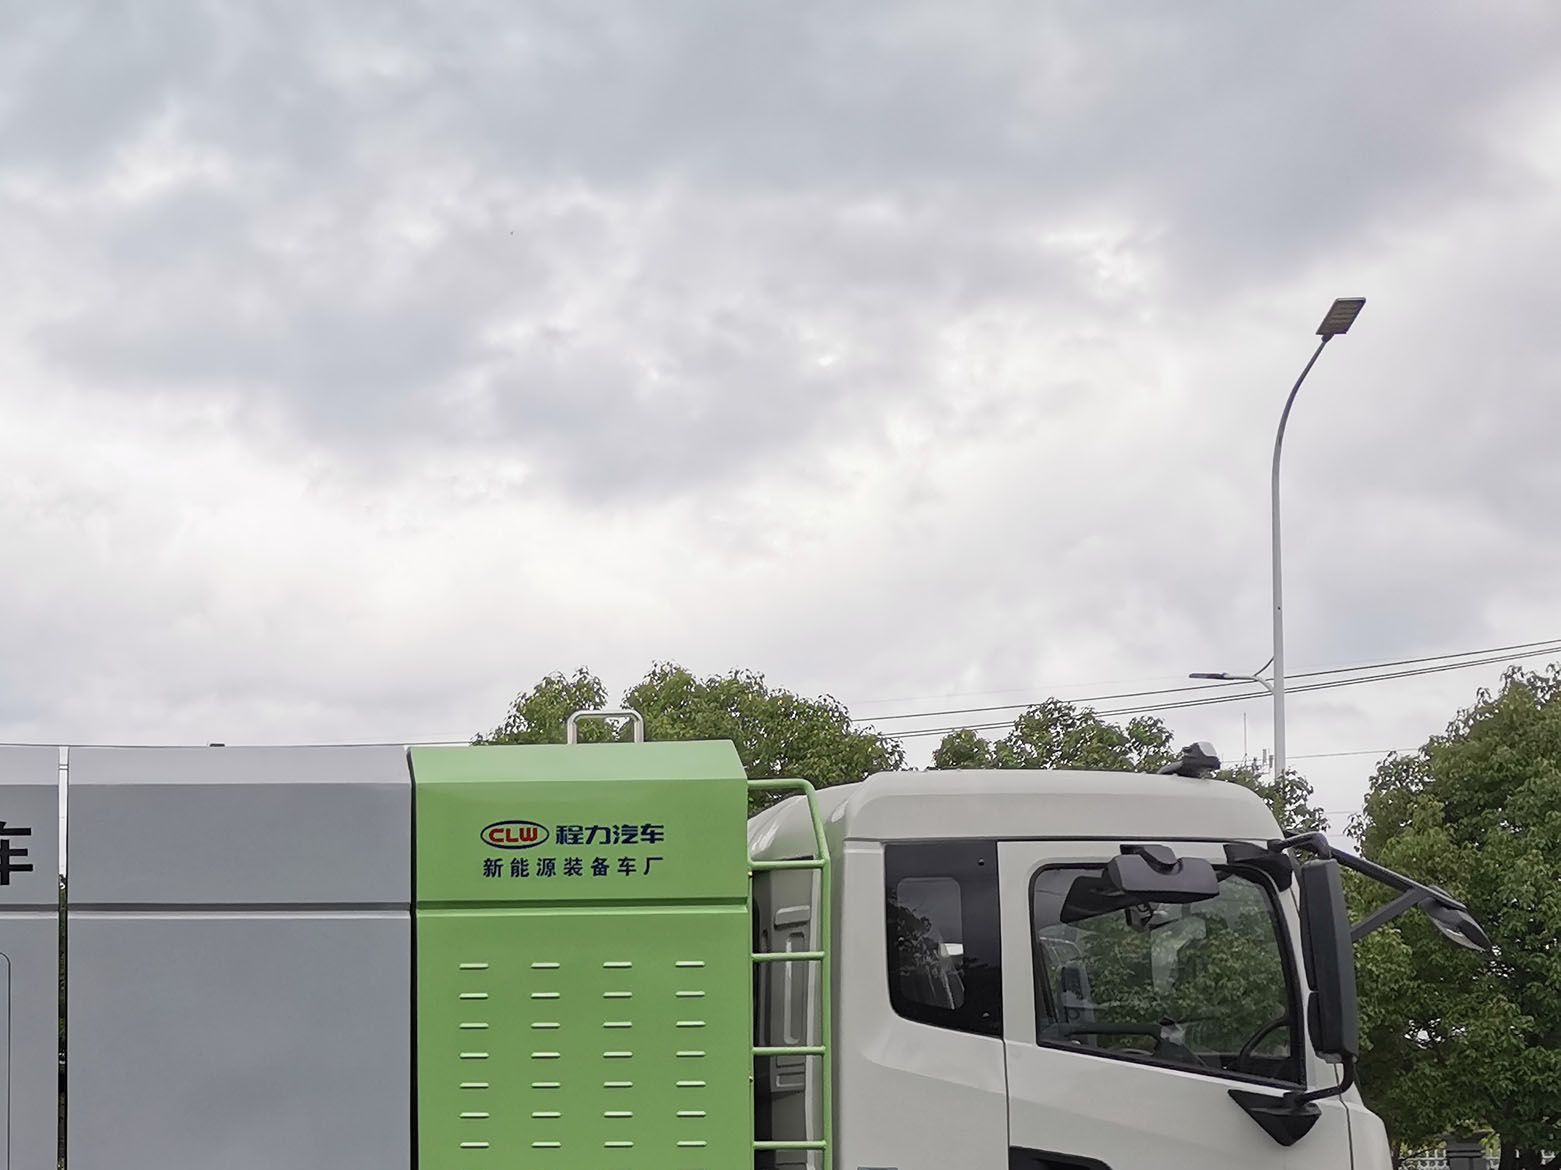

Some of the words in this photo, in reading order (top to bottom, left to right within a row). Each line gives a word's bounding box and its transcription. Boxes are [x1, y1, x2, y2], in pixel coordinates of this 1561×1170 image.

[488, 827, 539, 843] CLW
[555, 824, 665, 845] 程力汽车
[482, 857, 664, 878] 新能源装备车厂
